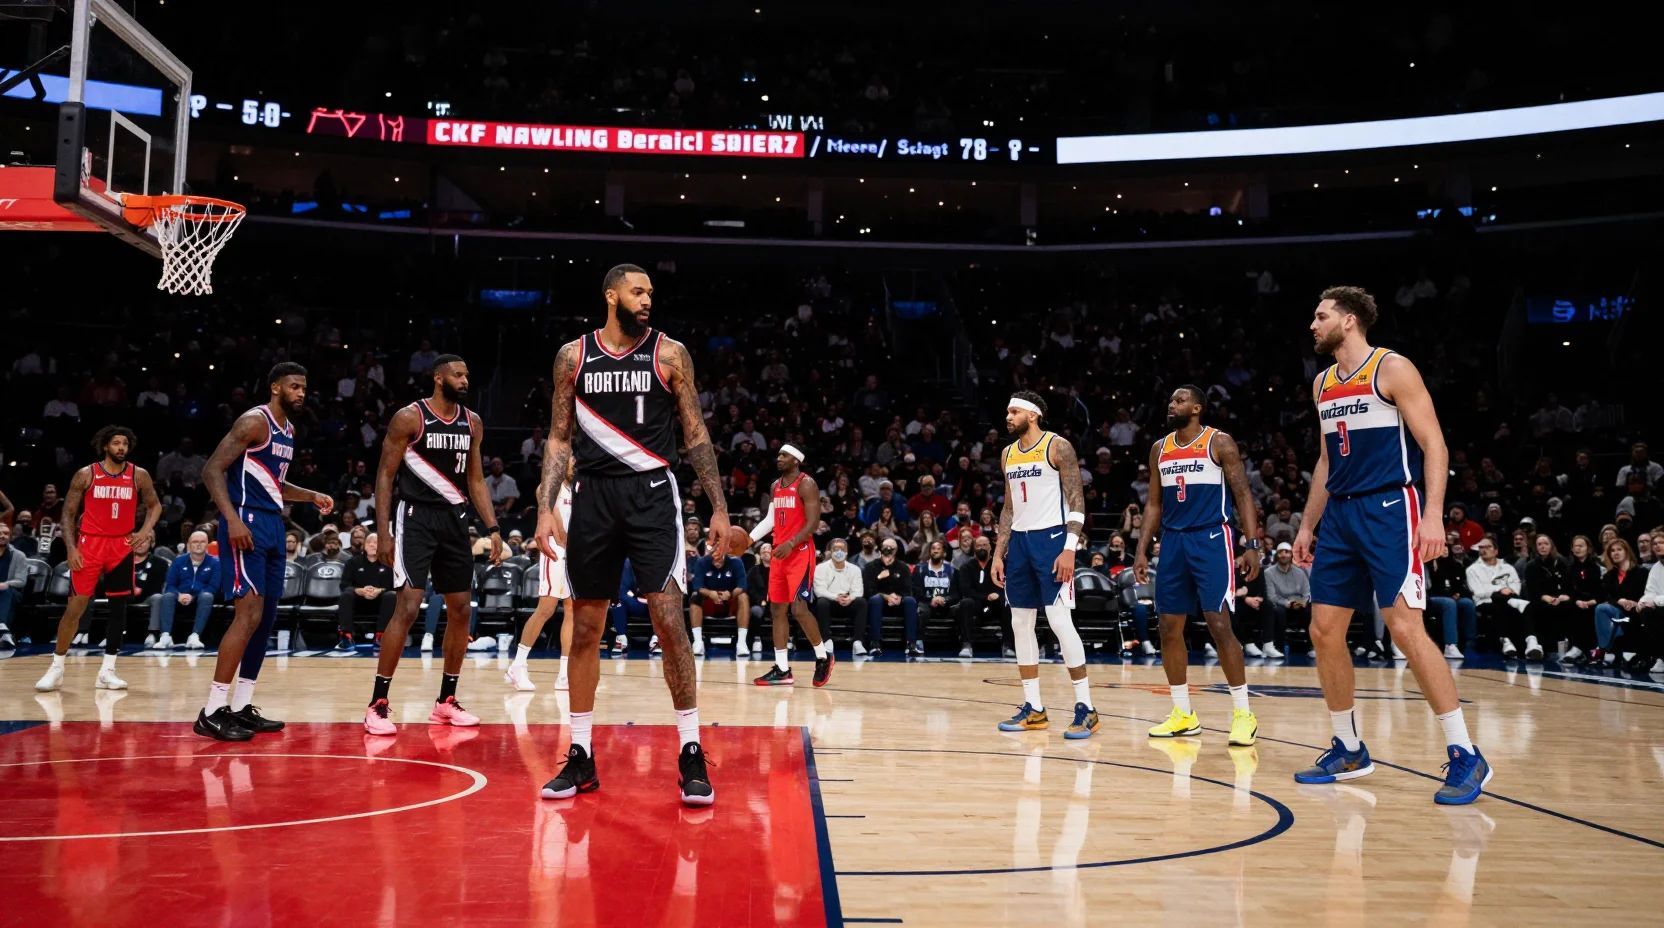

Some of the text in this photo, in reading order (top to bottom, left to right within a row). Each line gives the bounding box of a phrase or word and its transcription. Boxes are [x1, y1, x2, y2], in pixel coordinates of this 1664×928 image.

[435, 122, 486, 143] CKF
[495, 125, 608, 149] NAWLING
[634, 394, 645, 424] 1
